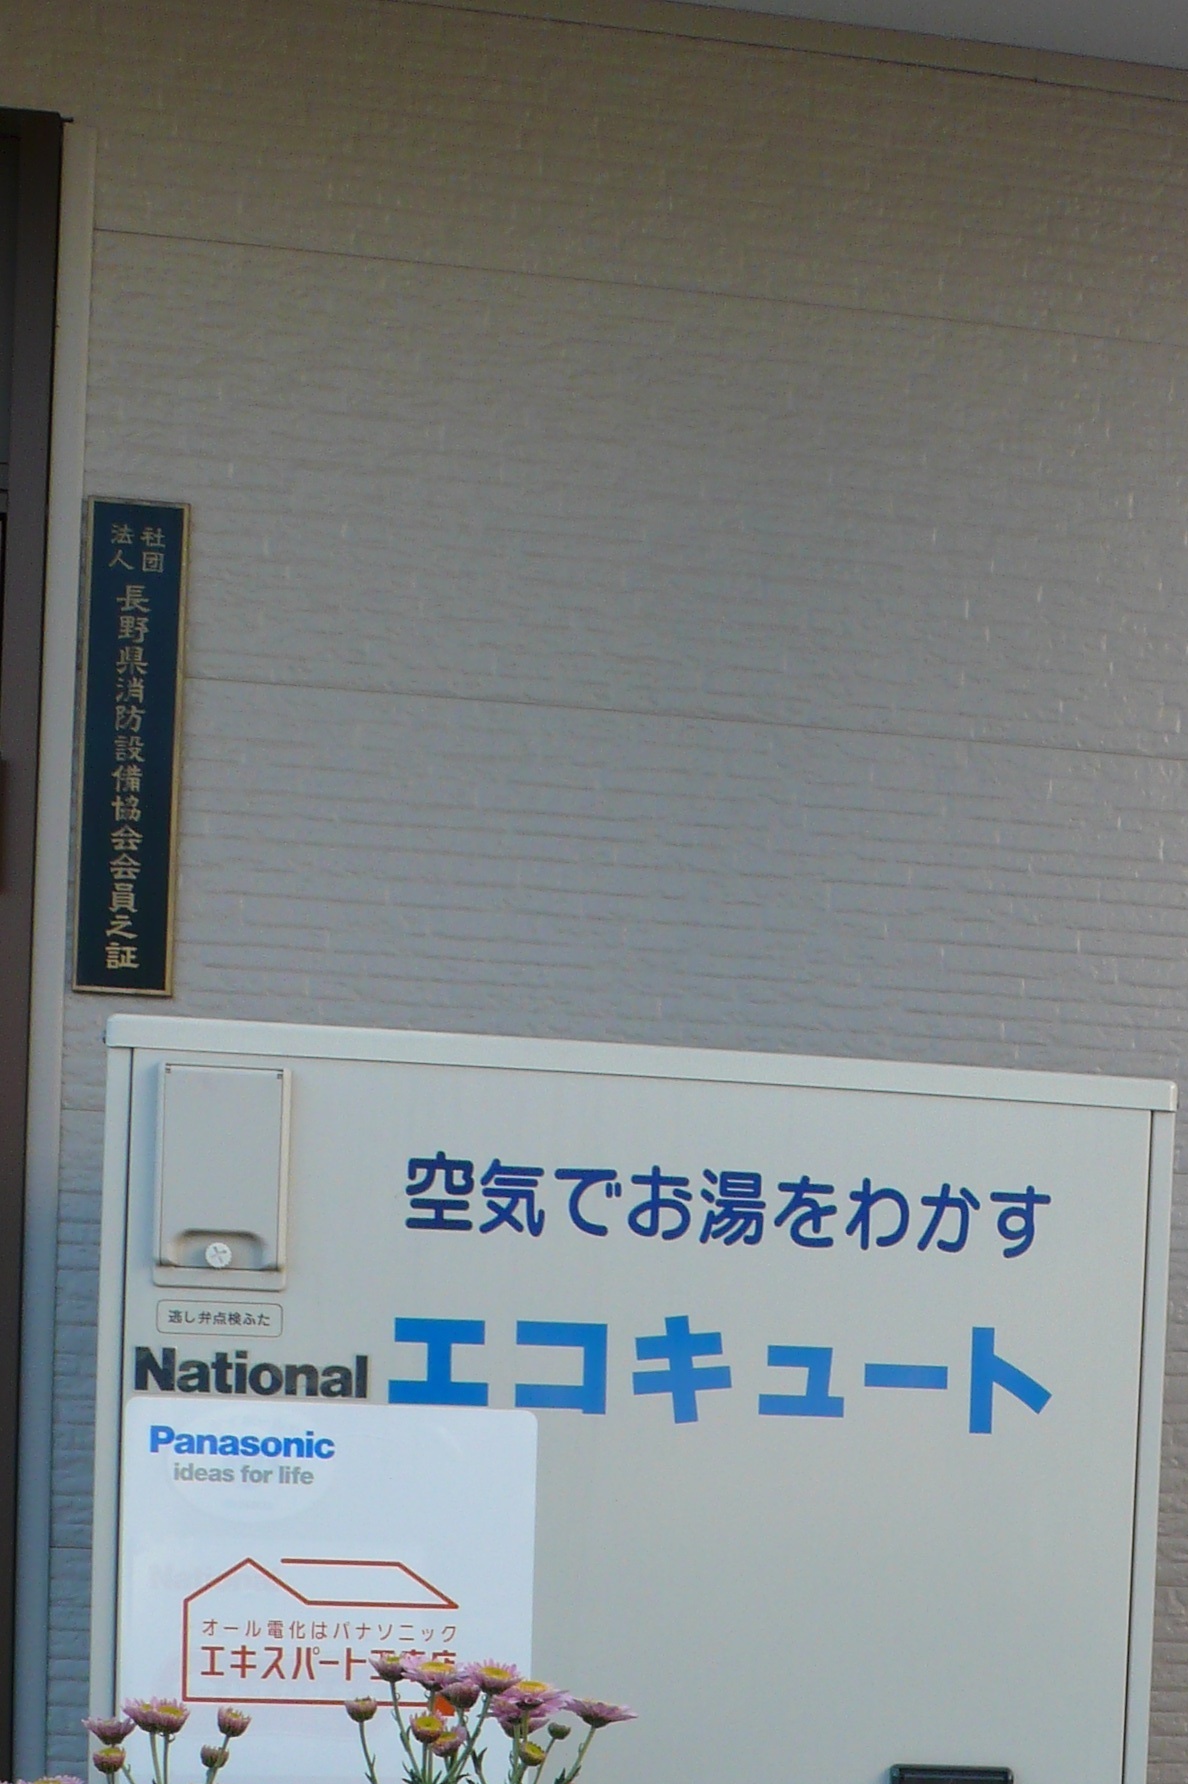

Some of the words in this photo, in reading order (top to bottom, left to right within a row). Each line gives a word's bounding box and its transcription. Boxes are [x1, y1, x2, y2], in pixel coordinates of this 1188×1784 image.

[105, 584, 150, 970] 長野県消防設備協会会員之証
[405, 1150, 1052, 1259] 空気でお湯をわかす
[168, 1310, 271, 1327] 逃し弁点検ふた
[134, 1345, 368, 1399] National
[387, 1314, 1052, 1434] エコキュート
[149, 1425, 336, 1459] Panasonic
[173, 1462, 235, 1483] ideas
[240, 1464, 274, 1484] for
[278, 1465, 315, 1486] life
[202, 1618, 458, 1643] オール電化はパナソニック
[200, 1644, 458, 1684] エキスパート工
